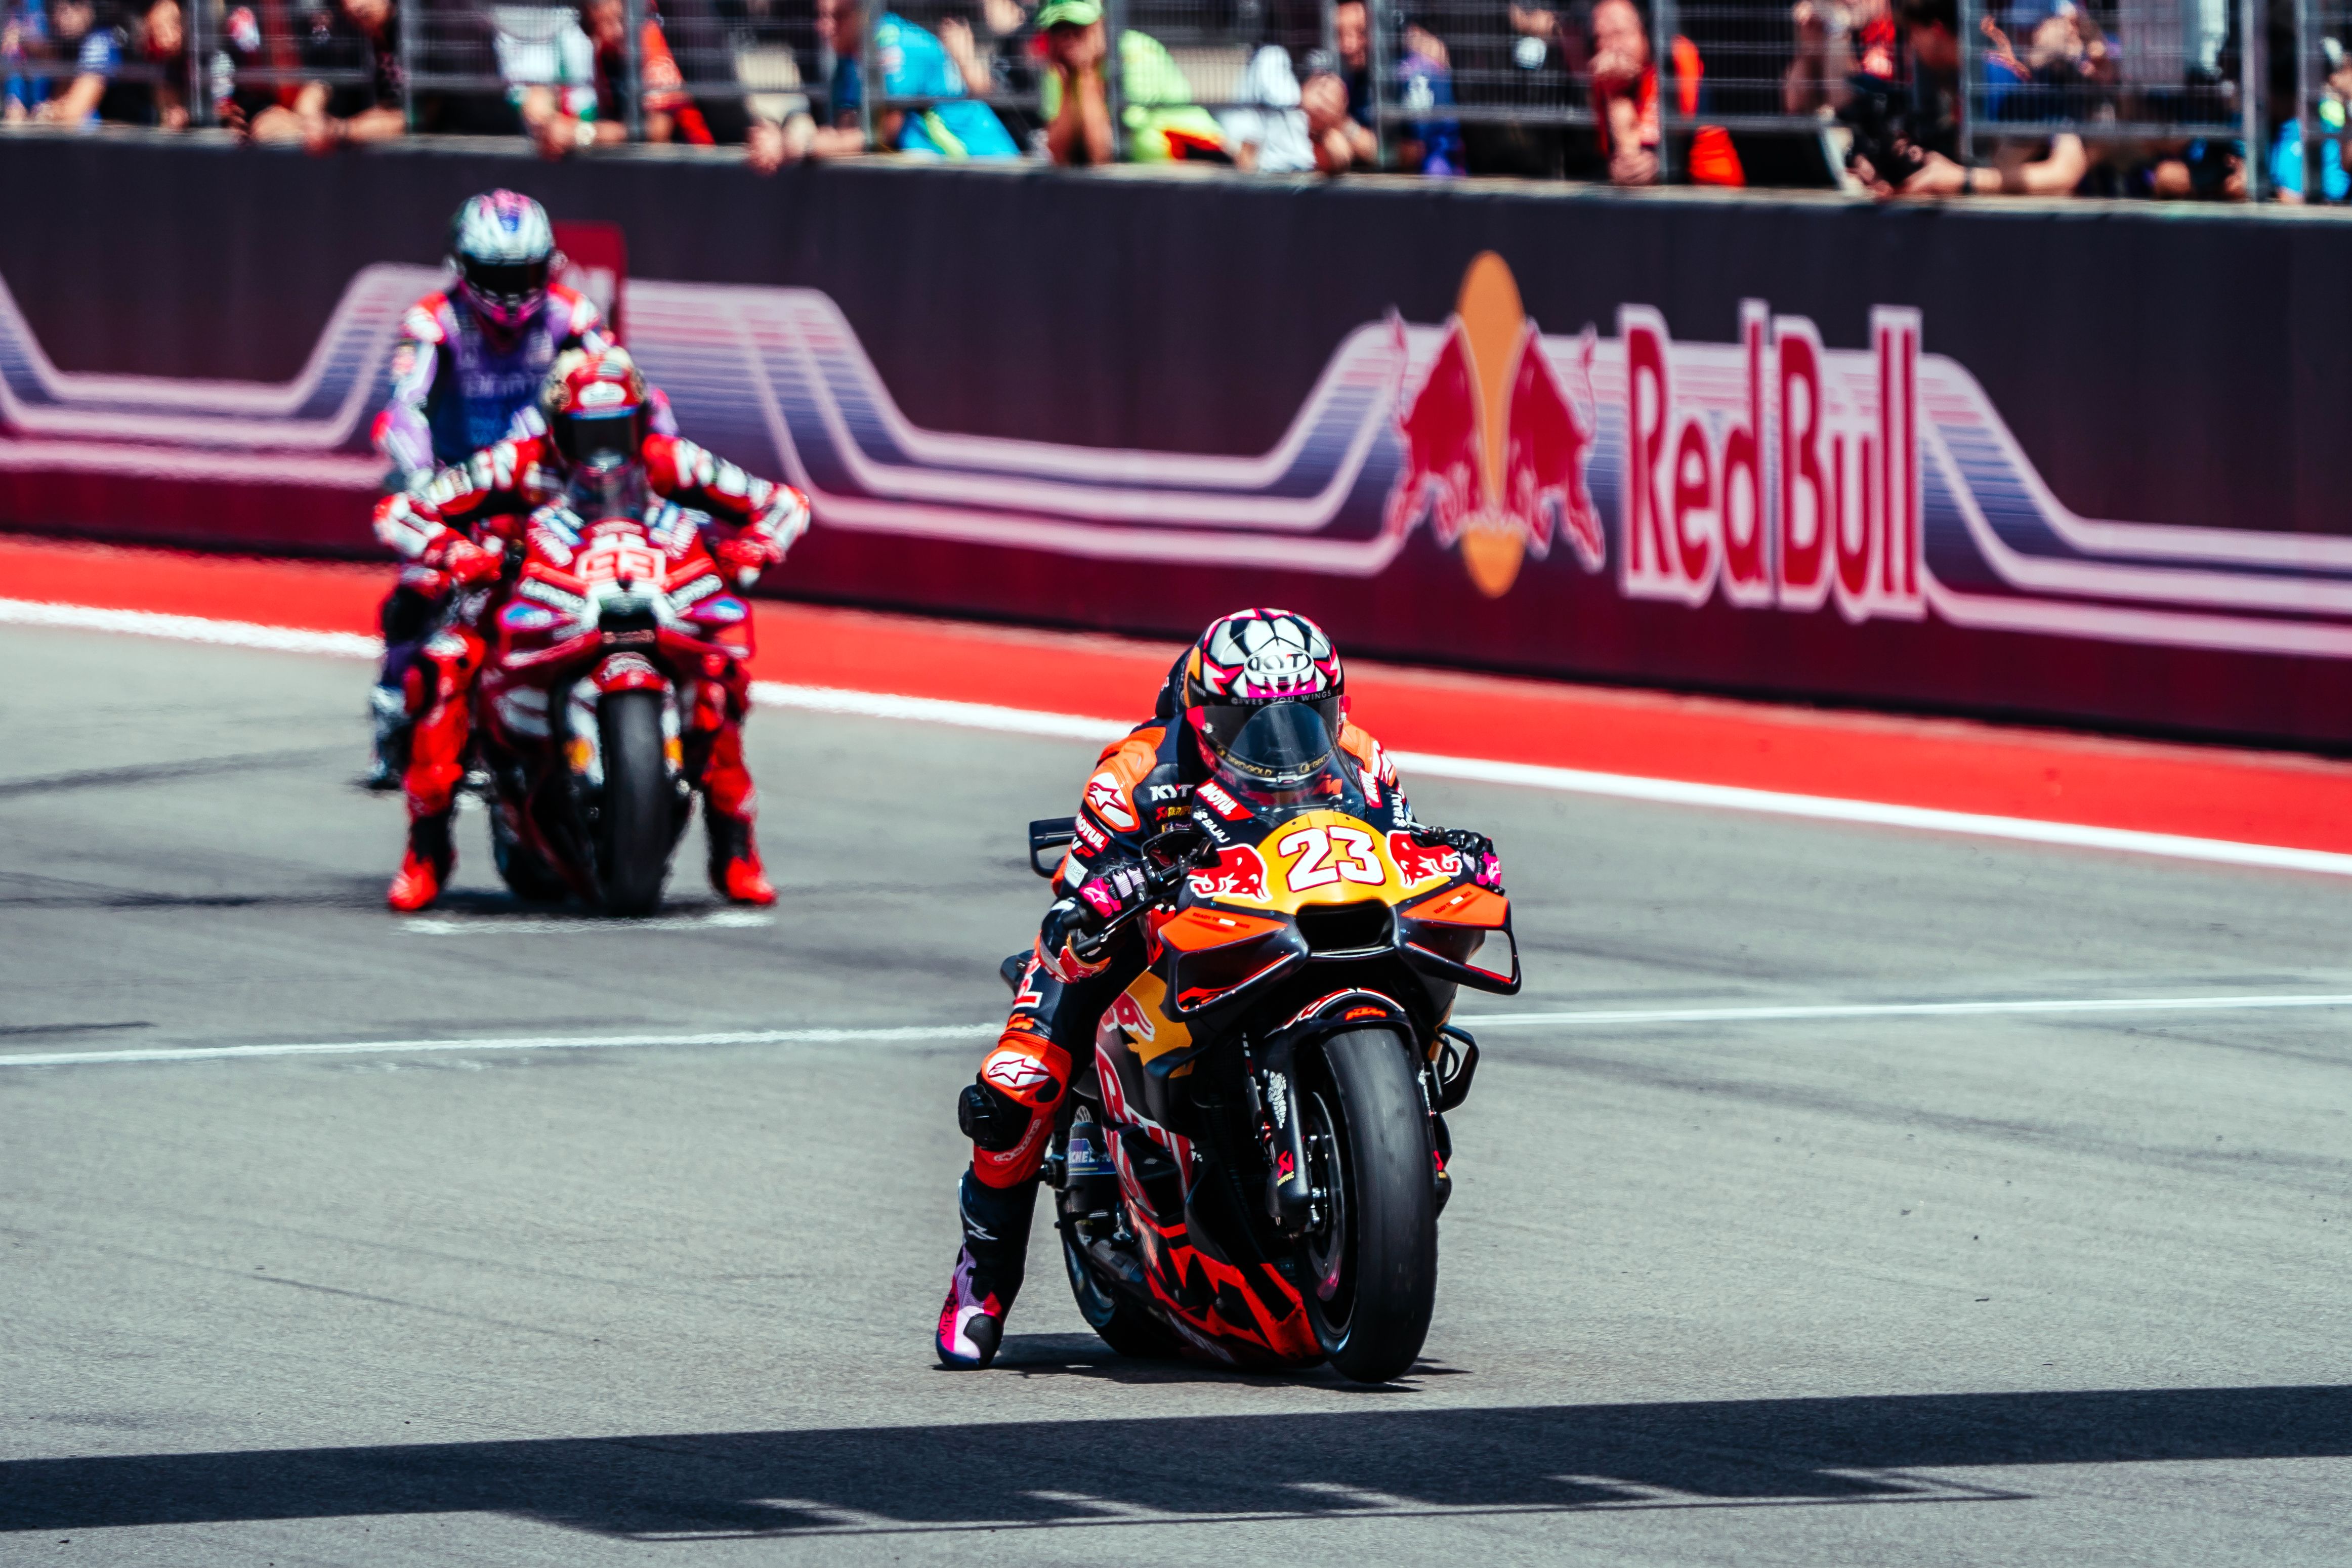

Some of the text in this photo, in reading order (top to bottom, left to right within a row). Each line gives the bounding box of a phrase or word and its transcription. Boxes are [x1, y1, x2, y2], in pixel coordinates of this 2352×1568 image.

[1231, 690, 1332, 705] GIVES YOU WINGS
[1150, 784, 1195, 801] KYT
[1197, 782, 1238, 816] MOTUL
[1076, 812, 1105, 849] MOTUL
[1202, 819, 1231, 843] BAJAJ
[1278, 825, 1386, 893] 23
